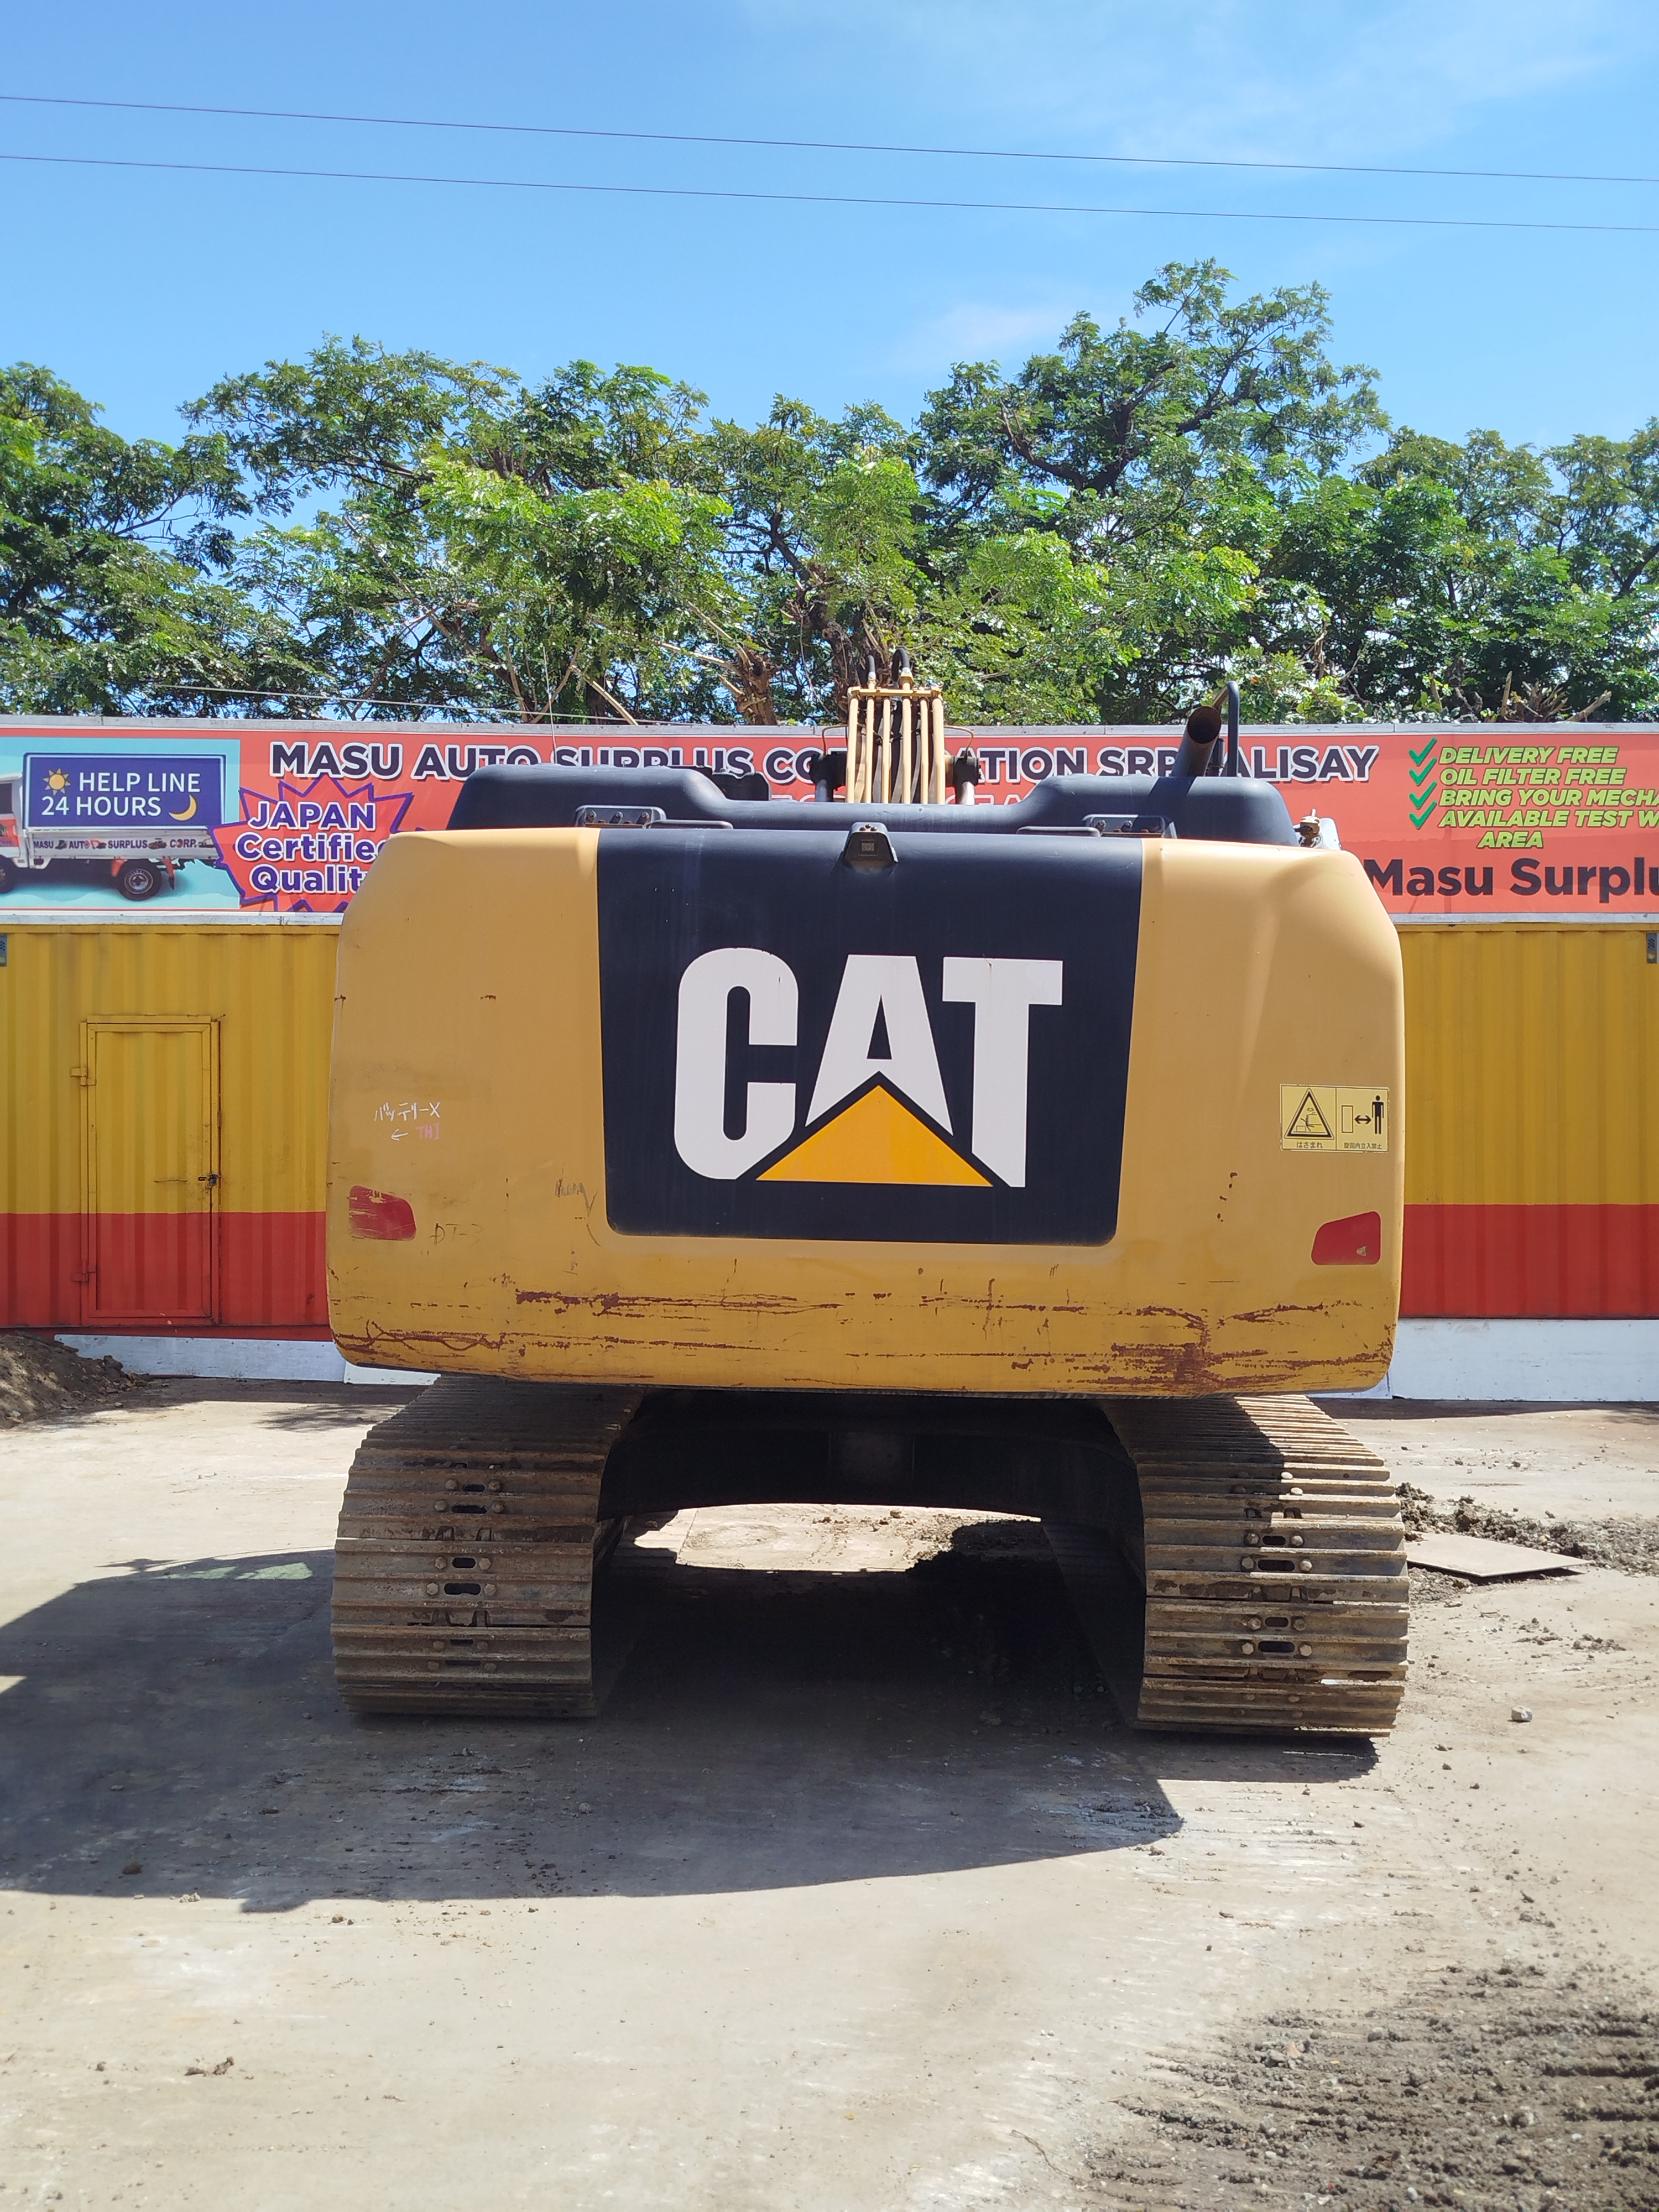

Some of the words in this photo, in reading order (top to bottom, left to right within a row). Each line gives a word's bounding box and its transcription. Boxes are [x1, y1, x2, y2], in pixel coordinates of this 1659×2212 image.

[270, 742, 403, 779] MASU
[1218, 744, 1380, 782] ALISAY
[1439, 747, 1554, 765] DELIVERY
[1557, 747, 1619, 765] FREE
[79, 772, 141, 792] HELP
[148, 773, 201, 792] LINE
[1439, 768, 1478, 785] OIL
[1483, 768, 1561, 785] FILTER
[1564, 768, 1627, 785] FREE
[41, 796, 70, 816] 24
[76, 796, 161, 816] HOURS
[1439, 789, 1512, 806] BRING
[1518, 789, 1583, 806] YOUR
[248, 801, 376, 831] JAPAN
[1437, 810, 1569, 827] AVAILABLE
[1574, 810, 1634, 828] TEST
[33, 841, 54, 849] MASU
[108, 840, 148, 849] SURPLUS
[236, 831, 387, 863] Certifie
[1477, 831, 1545, 848] AREA
[249, 864, 368, 894] Qualit
[1363, 859, 1494, 897] Masu
[674, 947, 1063, 1187] CAT
